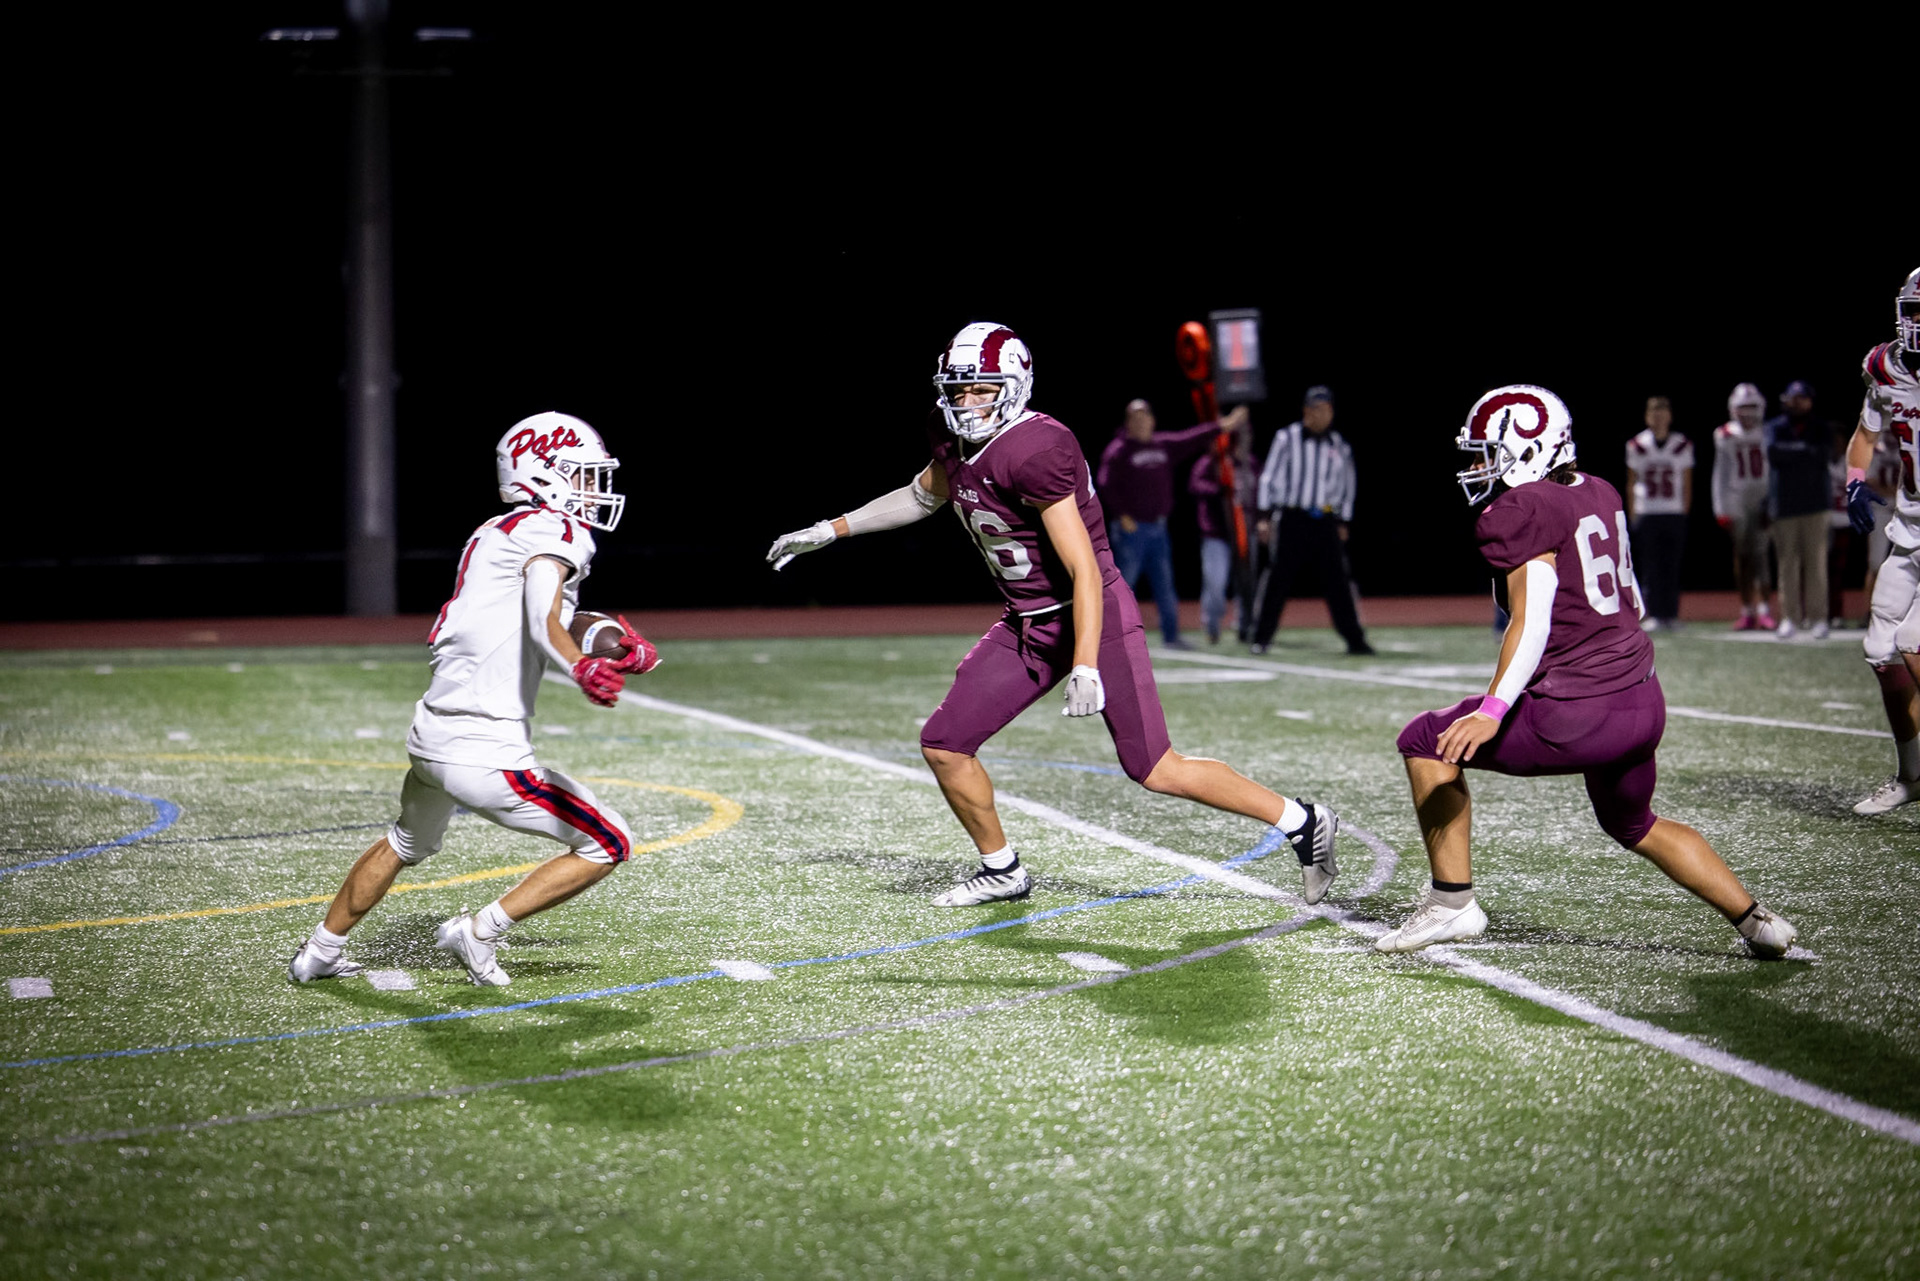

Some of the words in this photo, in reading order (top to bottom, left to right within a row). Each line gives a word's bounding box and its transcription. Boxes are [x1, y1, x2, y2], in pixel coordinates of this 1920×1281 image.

[506, 425, 582, 470] Pats
[561, 518, 575, 544] 1
[1574, 510, 1640, 616] 64
